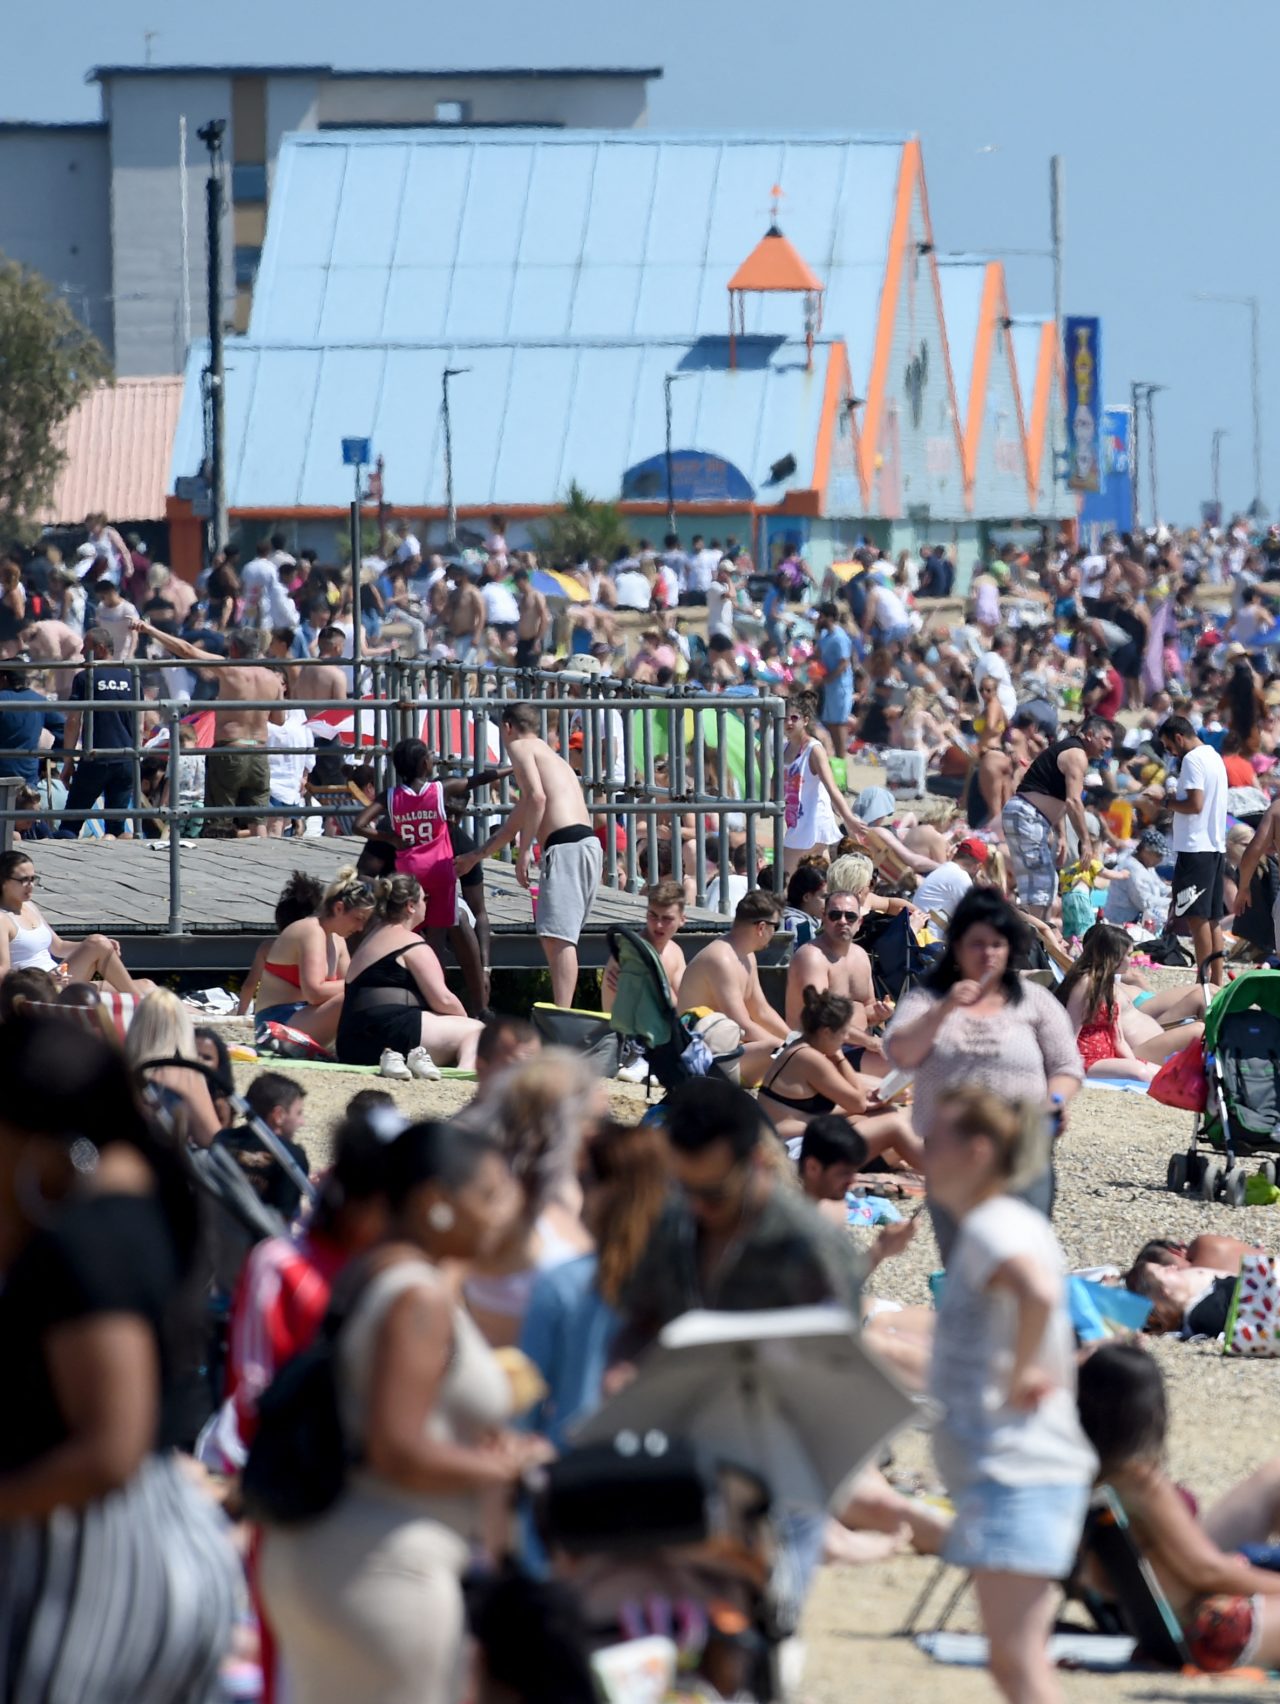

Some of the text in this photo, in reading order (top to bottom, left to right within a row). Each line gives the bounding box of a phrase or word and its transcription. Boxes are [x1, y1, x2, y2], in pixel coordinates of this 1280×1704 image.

[97, 679, 131, 691] S.C.P.
[394, 810, 438, 823] MALLORCA
[401, 821, 433, 846] 69
